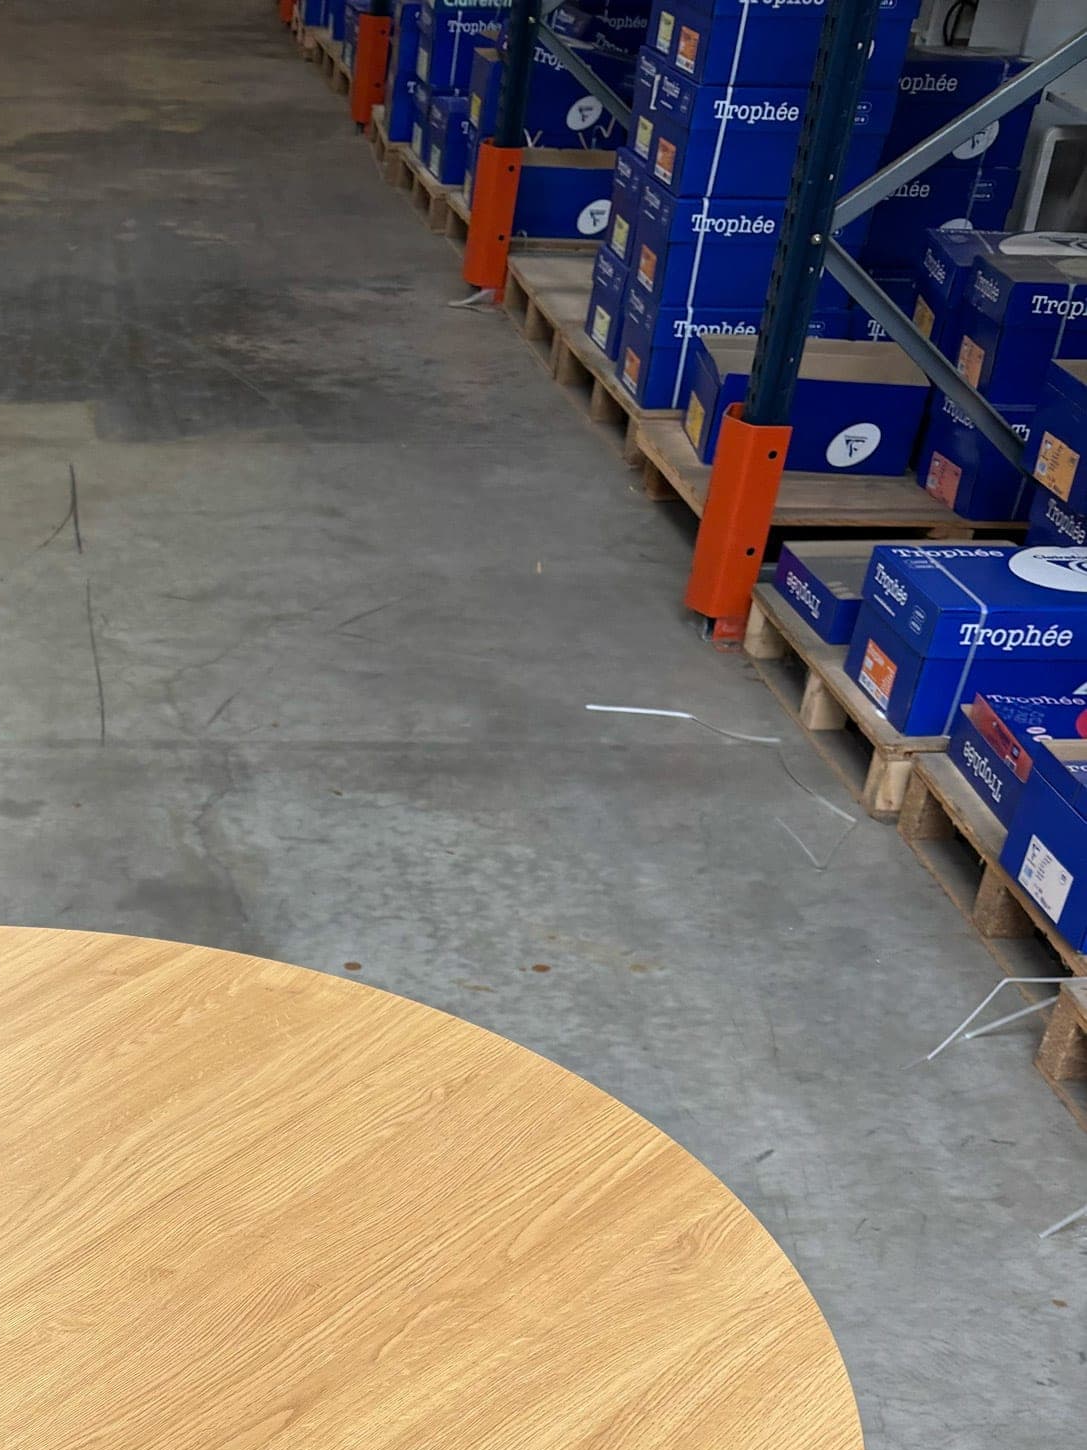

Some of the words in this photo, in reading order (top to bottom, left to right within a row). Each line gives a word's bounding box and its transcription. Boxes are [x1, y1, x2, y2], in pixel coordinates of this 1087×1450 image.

[899, 73, 958, 94] ophée
[714, 100, 800, 124] Trophée
[691, 214, 775, 236] Trophée
[1031, 294, 1087, 320] Trop
[891, 548, 1004, 559] Trophée
[959, 623, 1073, 651] Trophée
[985, 694, 1086, 706] Trophée
